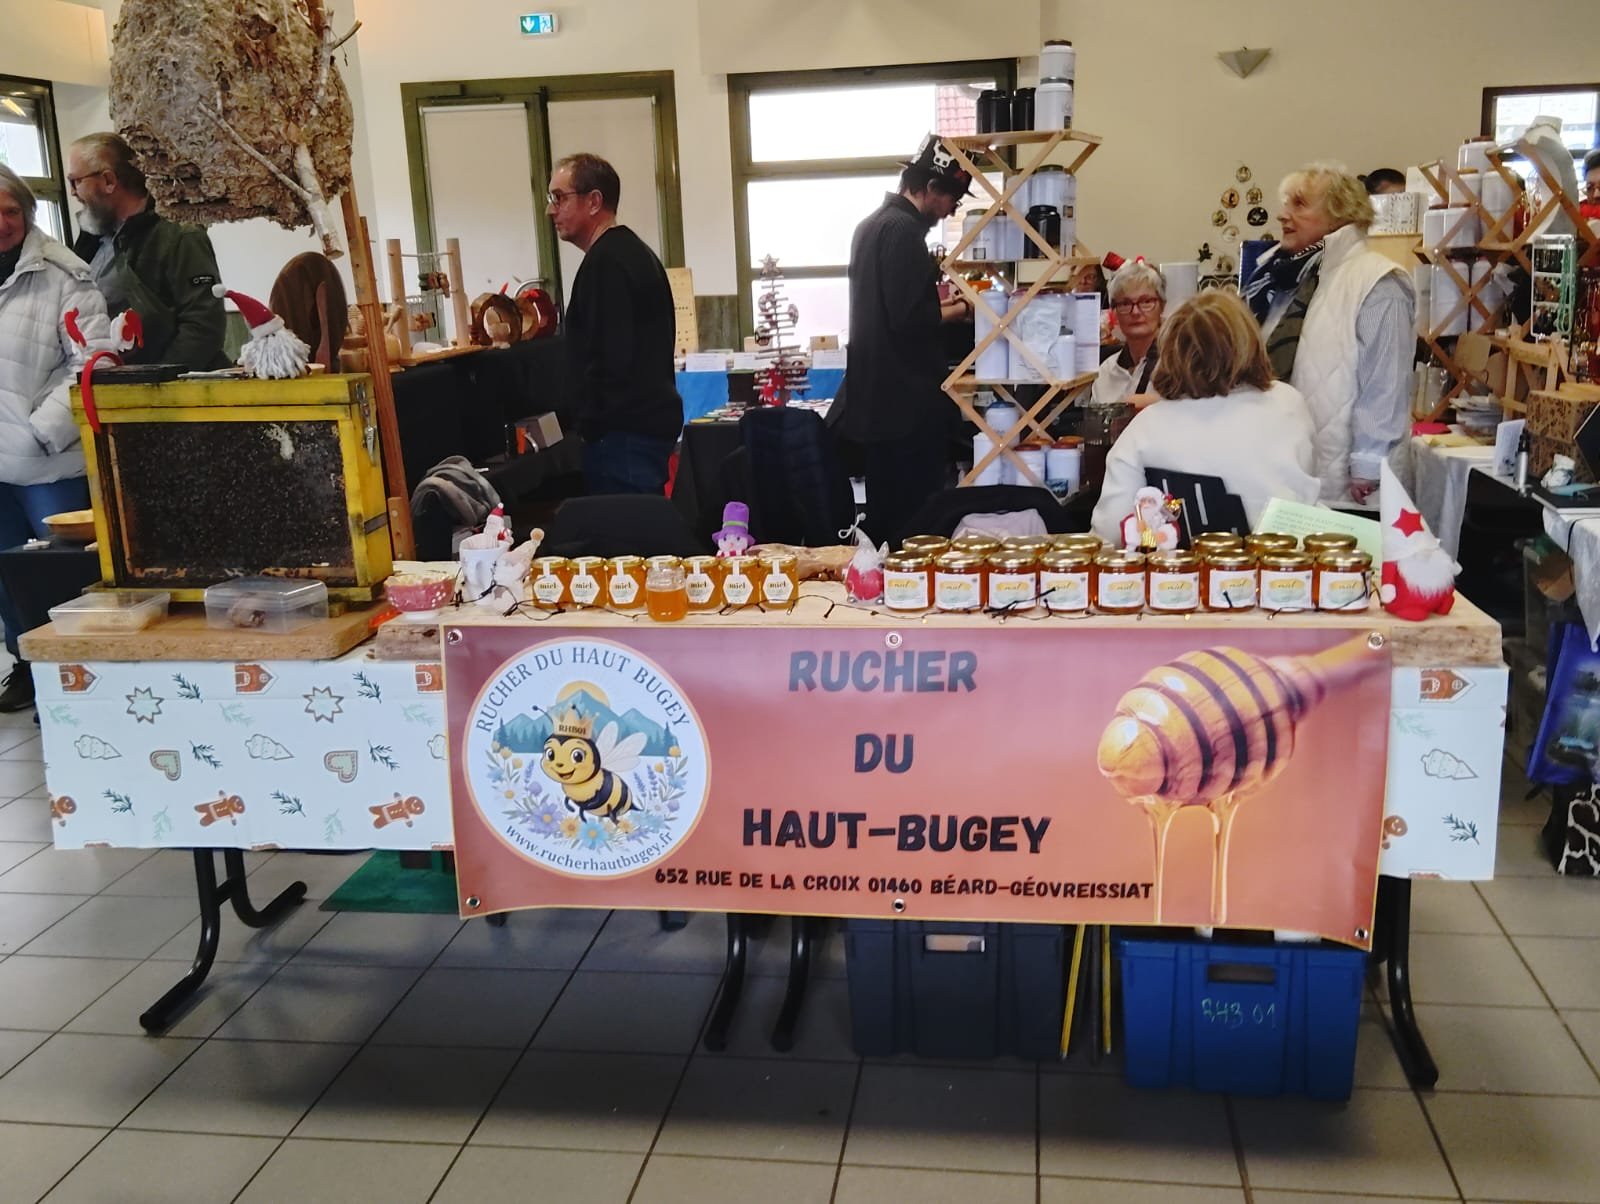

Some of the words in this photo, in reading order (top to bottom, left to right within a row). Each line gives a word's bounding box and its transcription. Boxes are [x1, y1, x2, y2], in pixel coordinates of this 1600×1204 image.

[615, 582, 631, 590] miel
[769, 580, 786, 588] miel
[476, 663, 532, 733] RUCHER
[534, 648, 564, 671] DU
[572, 647, 631, 673] HAUT
[632, 666, 690, 727] BUGEY
[788, 650, 978, 692] RUCHER
[854, 733, 914, 774] DU
[506, 825, 673, 871] www.rucherhautbugey.fr
[743, 808, 1051, 854] HAUT-BUGEY
[655, 868, 688, 884] 652
[695, 870, 732, 886] RUE
[739, 872, 763, 888] DE
[770, 874, 796, 890] LA
[803, 875, 860, 891] CROIX
[868, 877, 922, 894] 01460
[930, 874, 1154, 899] BÉARD-GÉOVREISSIAT
